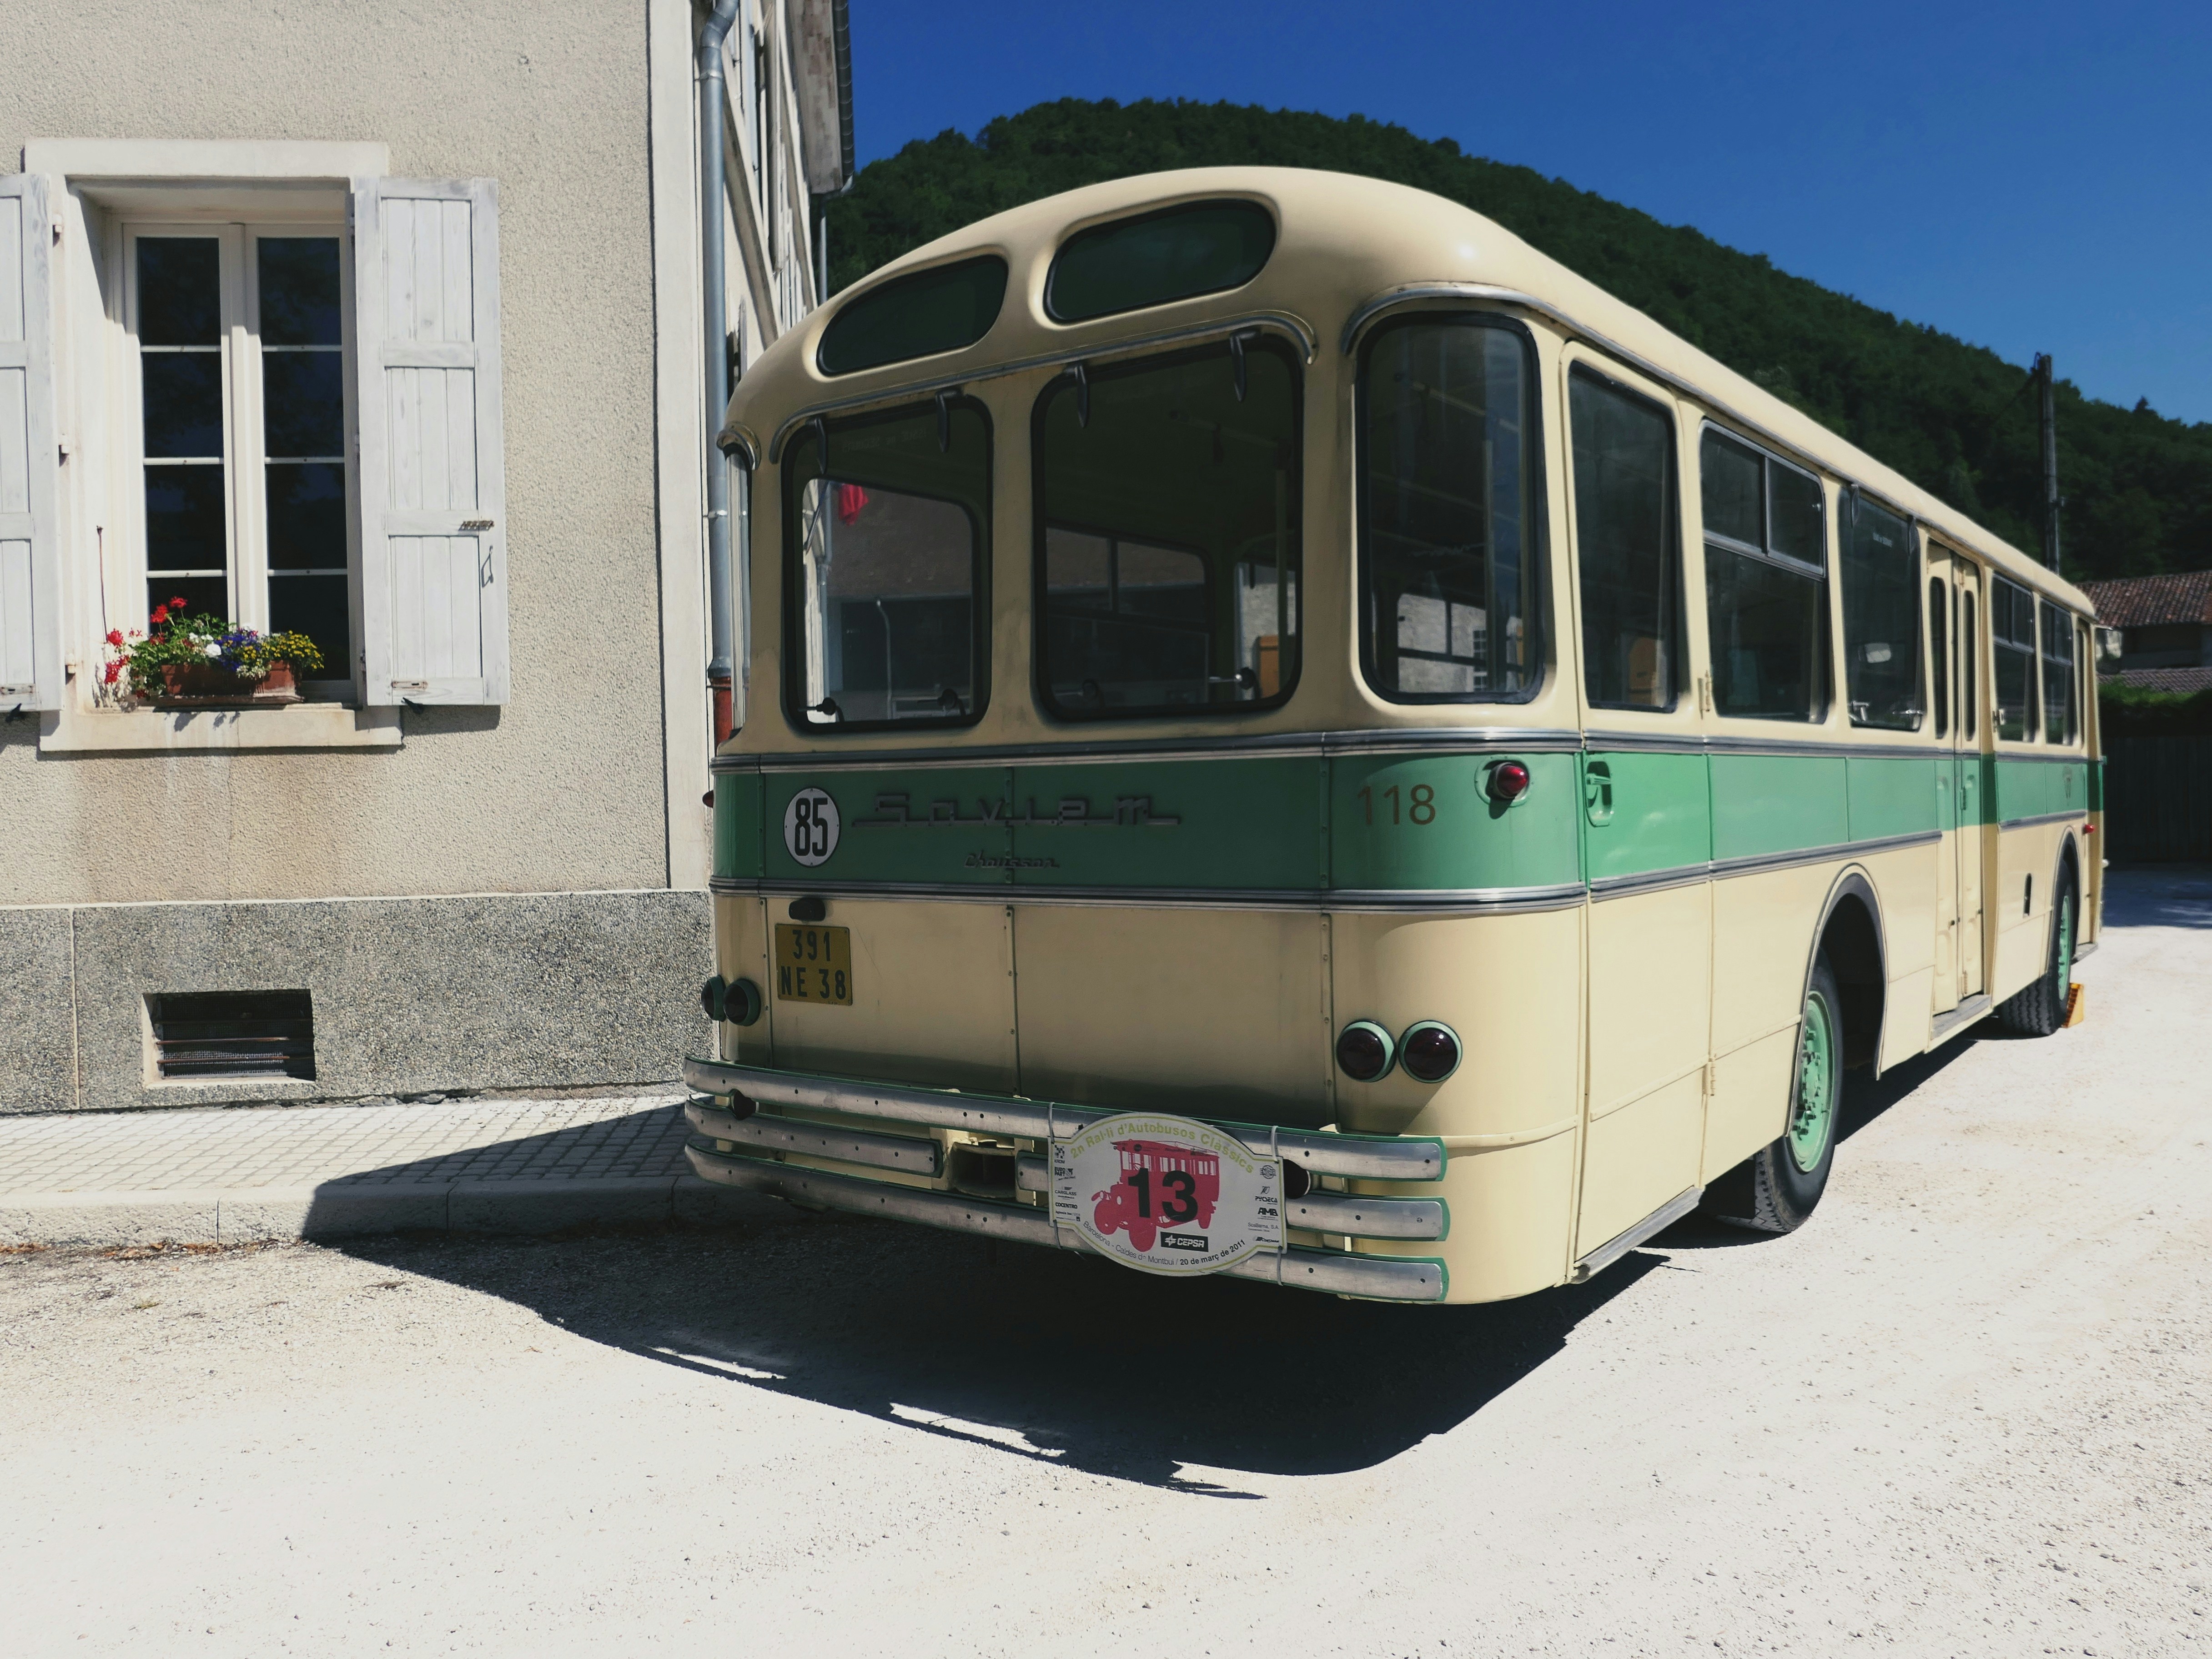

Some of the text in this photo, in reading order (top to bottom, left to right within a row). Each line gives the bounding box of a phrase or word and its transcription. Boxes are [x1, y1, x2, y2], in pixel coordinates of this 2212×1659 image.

[1357, 783, 1437, 826] 118
[793, 797, 829, 856] 85
[964, 849, 1061, 869] Chausson
[792, 930, 831, 962] 391
[780, 965, 846, 1000] NE 38
[1070, 1145, 1085, 1159] 2n
[1117, 1122, 1196, 1140] d'Autobusos
[1128, 1167, 1198, 1222] 13
[1083, 1221, 1110, 1246] Barcelona
[1148, 1255, 1174, 1265] Montbui
[1201, 1253, 1219, 1263] març
[1229, 1239, 1245, 1253] 2011
[1177, 1237, 1205, 1248] CEPSA
